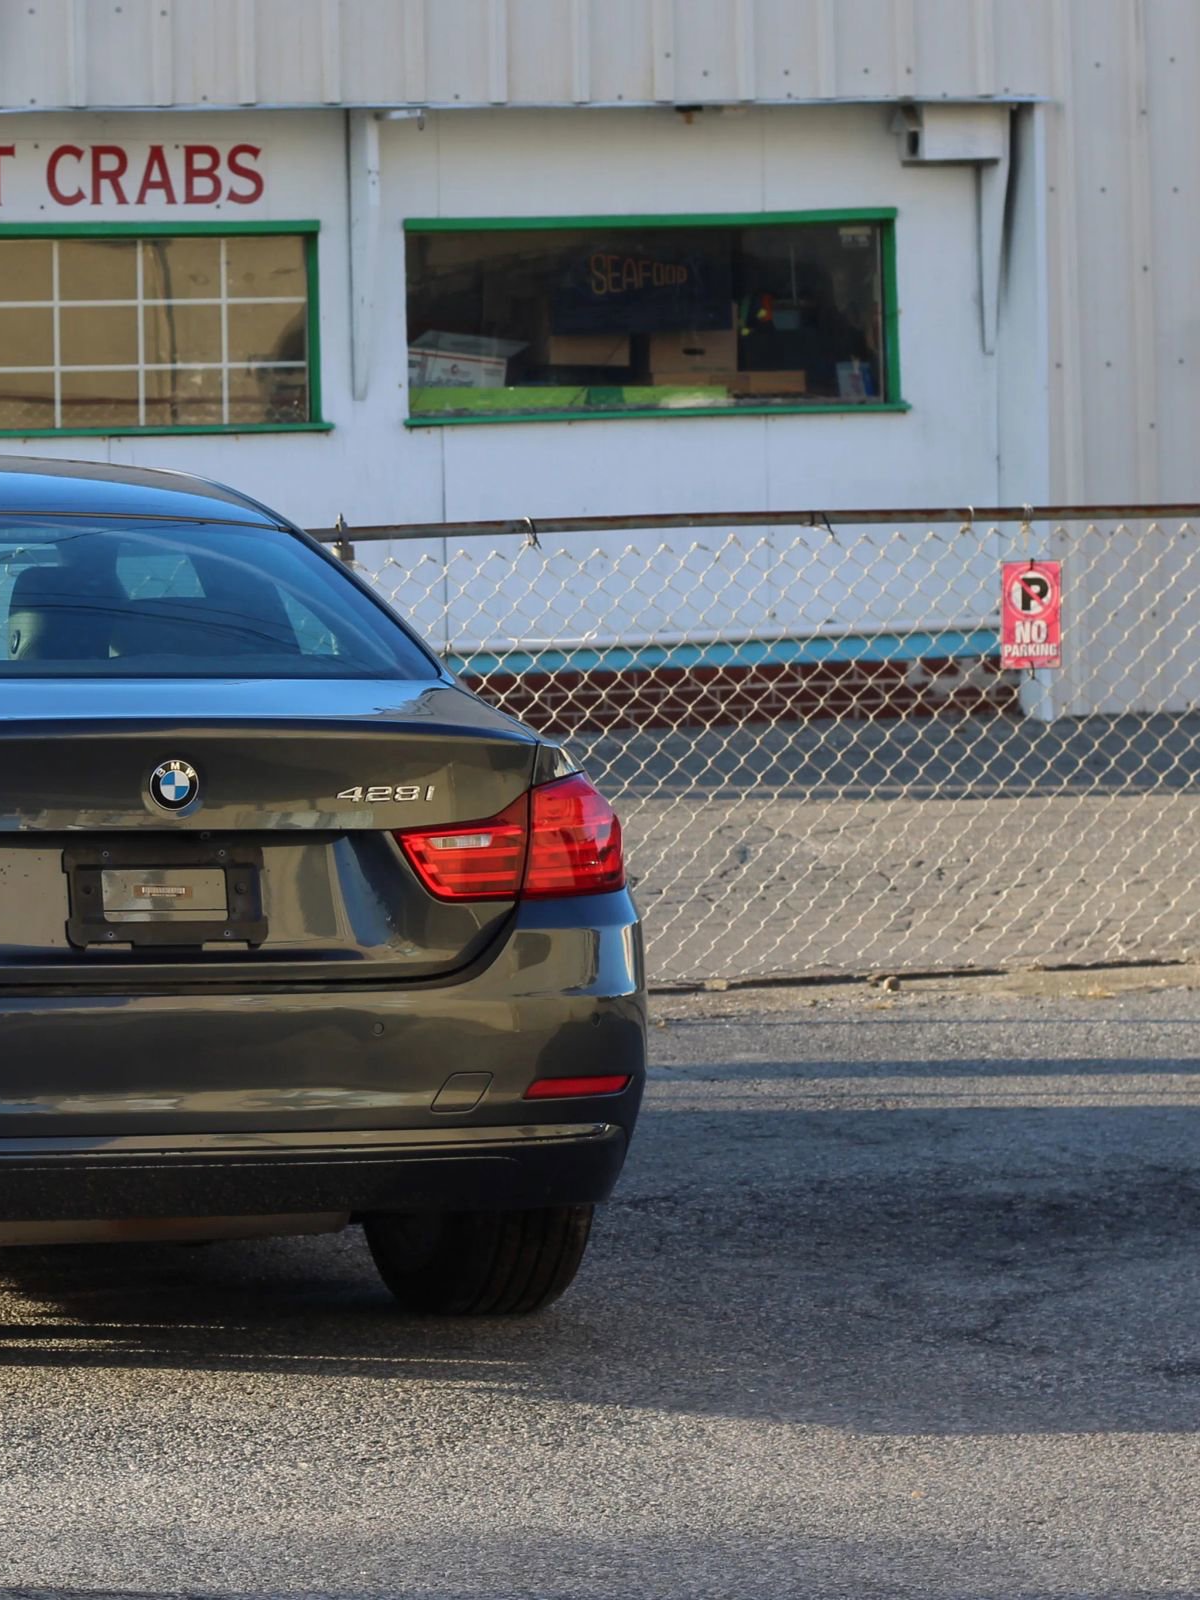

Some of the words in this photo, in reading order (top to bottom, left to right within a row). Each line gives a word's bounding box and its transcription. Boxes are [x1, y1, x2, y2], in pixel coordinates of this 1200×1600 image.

[46, 144, 265, 206] CRABS
[590, 253, 688, 295] SEAFOOD
[1015, 620, 1048, 644] NO
[1004, 643, 1058, 658] PARKING
